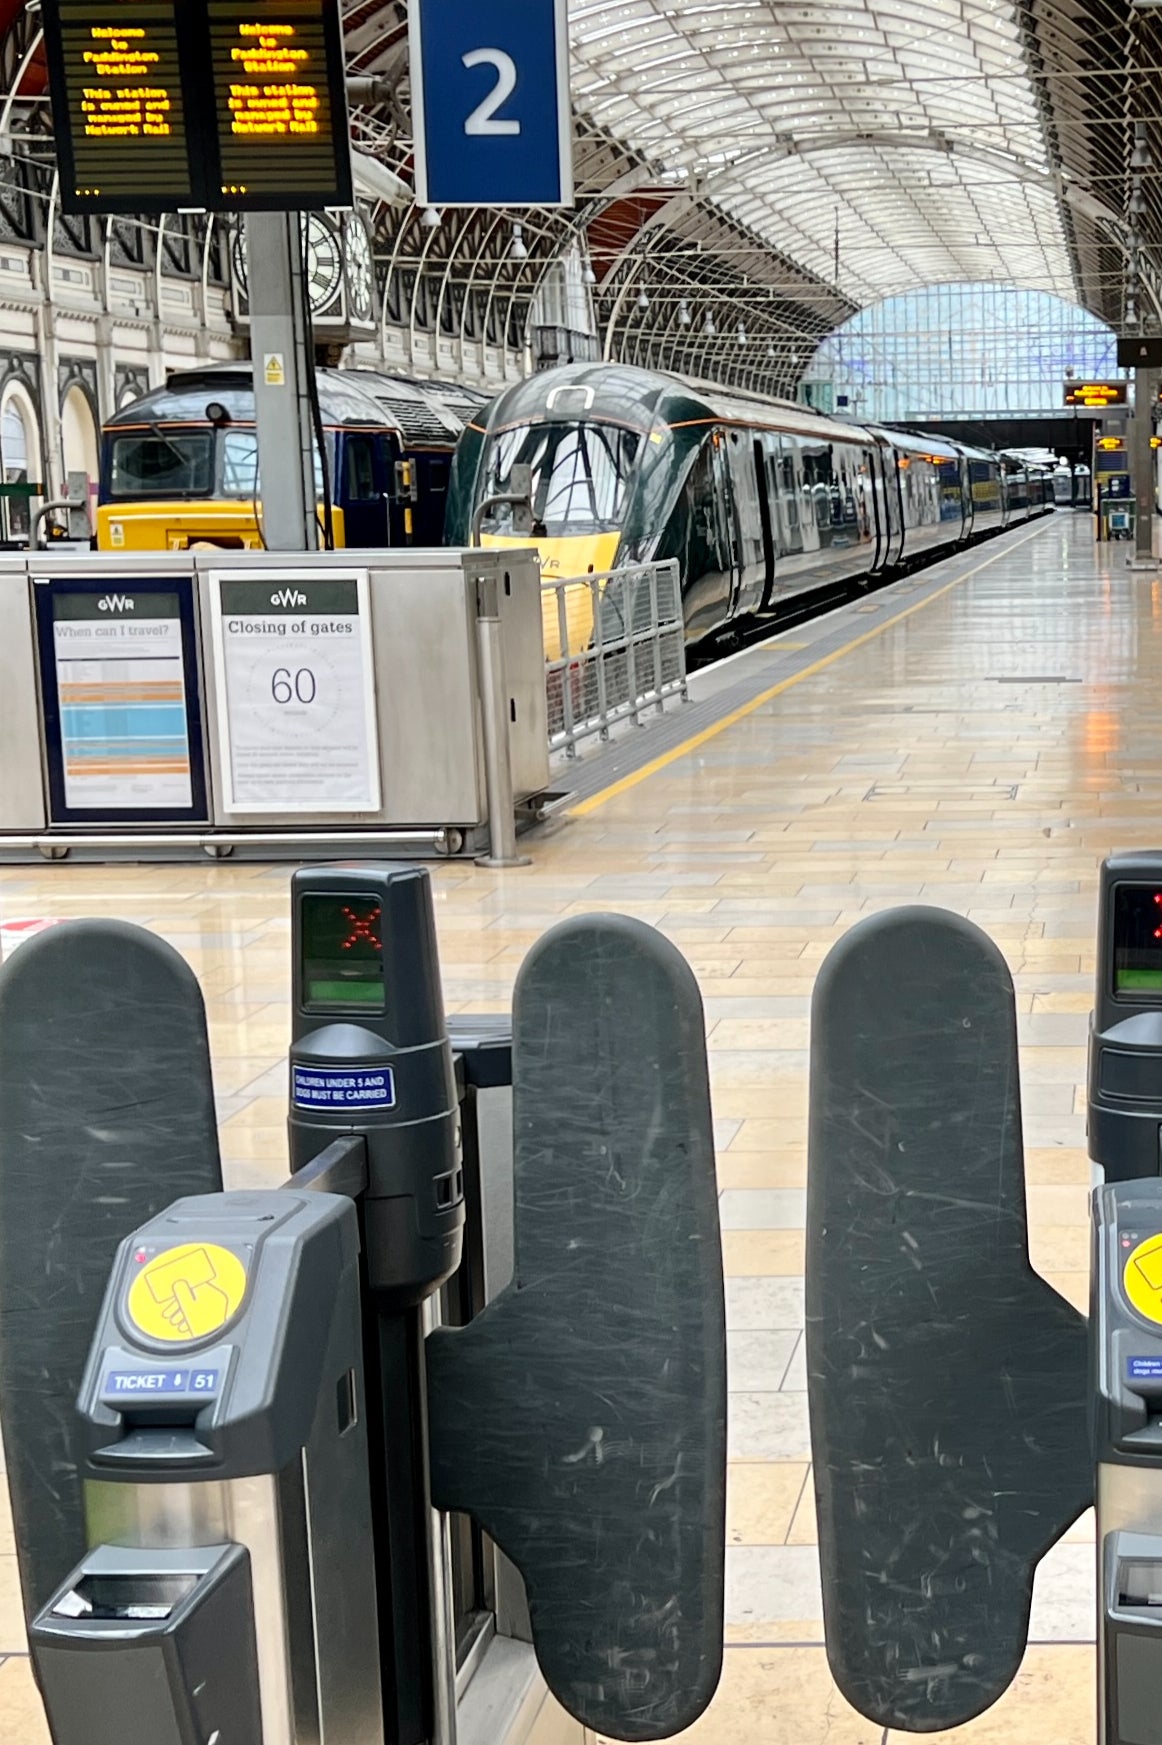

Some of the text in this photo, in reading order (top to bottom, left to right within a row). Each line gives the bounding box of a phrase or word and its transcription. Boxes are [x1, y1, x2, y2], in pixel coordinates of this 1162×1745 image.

[91, 27, 145, 38] Welcome
[239, 23, 294, 36] Welcome
[111, 39, 128, 50] to
[259, 36, 277, 48] to
[83, 51, 159, 62] Paddington
[231, 48, 308, 61] Paddington
[96, 64, 148, 75] Station
[243, 60, 297, 72] Station
[83, 87, 167, 99] This station
[229, 83, 316, 97] This station
[461, 47, 520, 135] 2
[81, 99, 170, 111] is owned and
[228, 96, 318, 108] is owned and
[88, 112, 163, 123] managed by
[234, 108, 314, 121] managed by
[85, 123, 170, 135] Network Rail
[231, 120, 318, 133] Network Rail
[97, 594, 134, 613] GWR
[270, 588, 307, 608] GWR
[56, 624, 169, 637] When can I travel?
[228, 620, 353, 636] Closing of gates
[271, 668, 316, 704] 60
[295, 1075, 384, 1088] CHILDREN UNDER 5 AND
[311, 1090, 331, 1100] MUST
[333, 1091, 345, 1100] BE
[346, 1089, 387, 1100] CARRIED
[114, 1374, 214, 1390] TICKET 51
